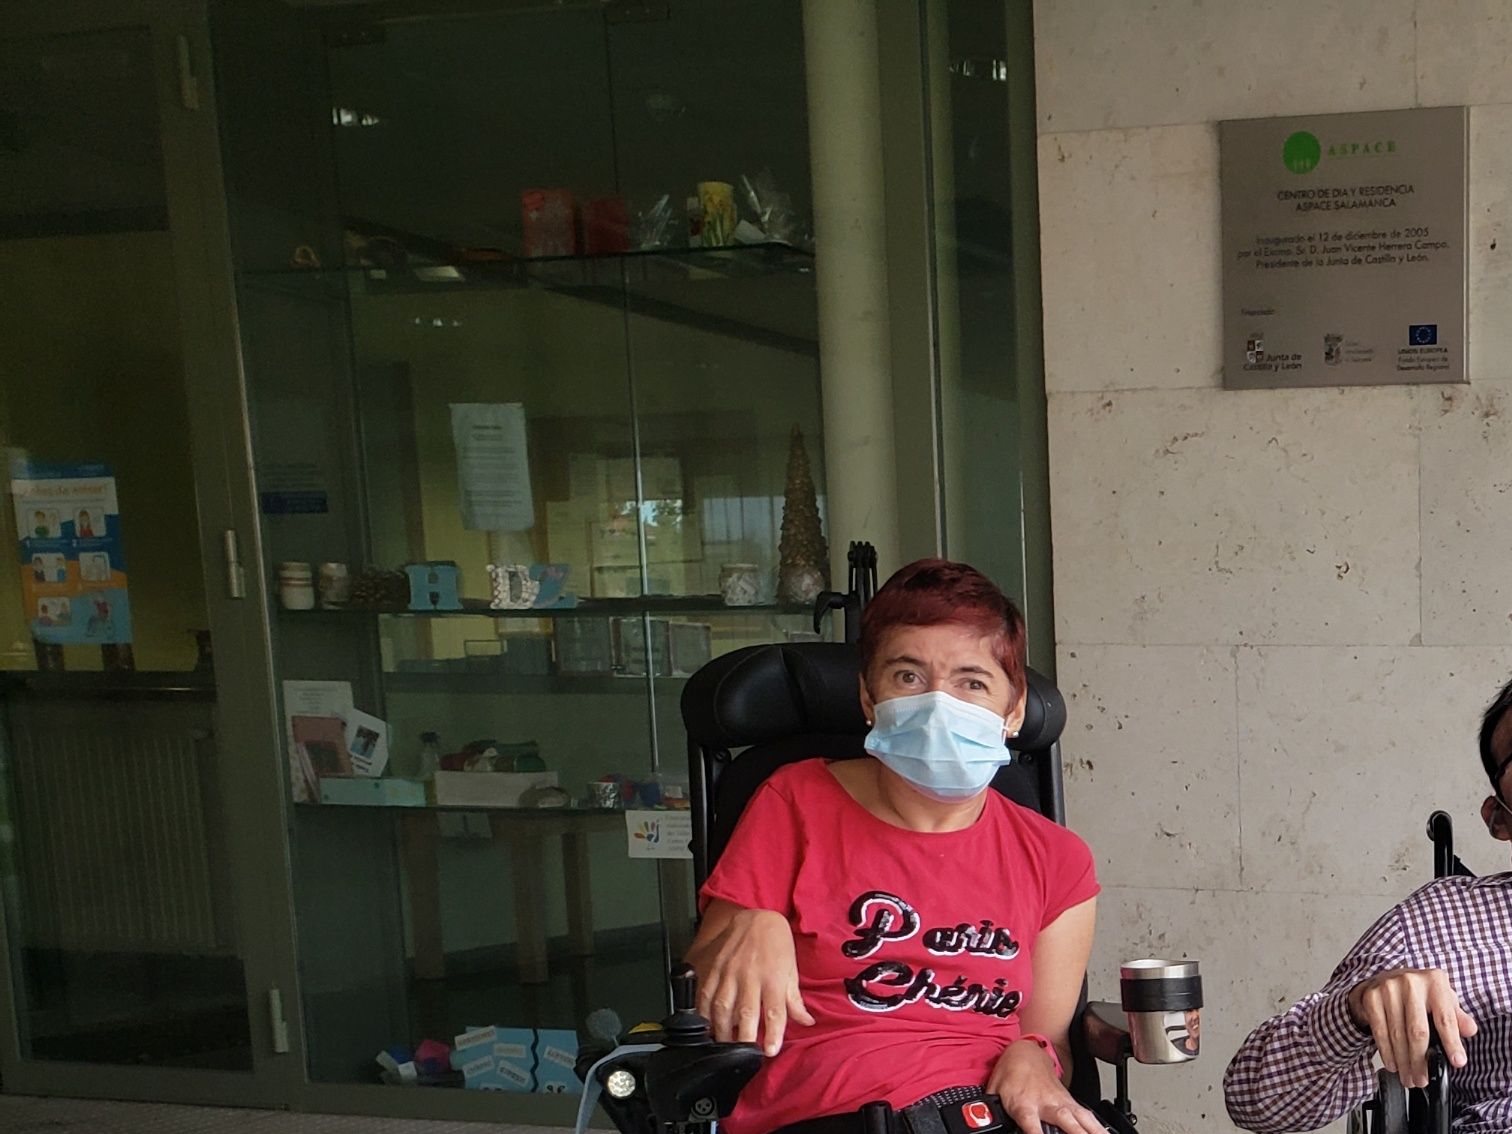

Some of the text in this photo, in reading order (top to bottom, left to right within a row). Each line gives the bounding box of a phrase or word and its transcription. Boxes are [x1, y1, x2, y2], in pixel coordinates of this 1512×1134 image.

[1328, 141, 1396, 156] ASPACE
[1277, 189, 1315, 201] CENTRO
[1318, 187, 1330, 199] DE
[1350, 187, 1358, 197] Y
[1359, 184, 1415, 197] RESIDENCIA
[1296, 198, 1397, 211] ASPACE SALAMANCA
[1319, 232, 1330, 242] 12
[1331, 231, 1344, 241] de
[1345, 229, 1387, 240] diciembre
[1390, 228, 1402, 239] de
[1404, 227, 1430, 239] 2005
[1322, 245, 1343, 254] Juan
[1344, 242, 1377, 253] Vicente
[1379, 241, 1413, 251] Herrera
[1326, 256, 1349, 267] Junta
[1351, 255, 1363, 265] de
[841, 891, 1020, 960] Paris
[844, 961, 1023, 1019] Chérie
